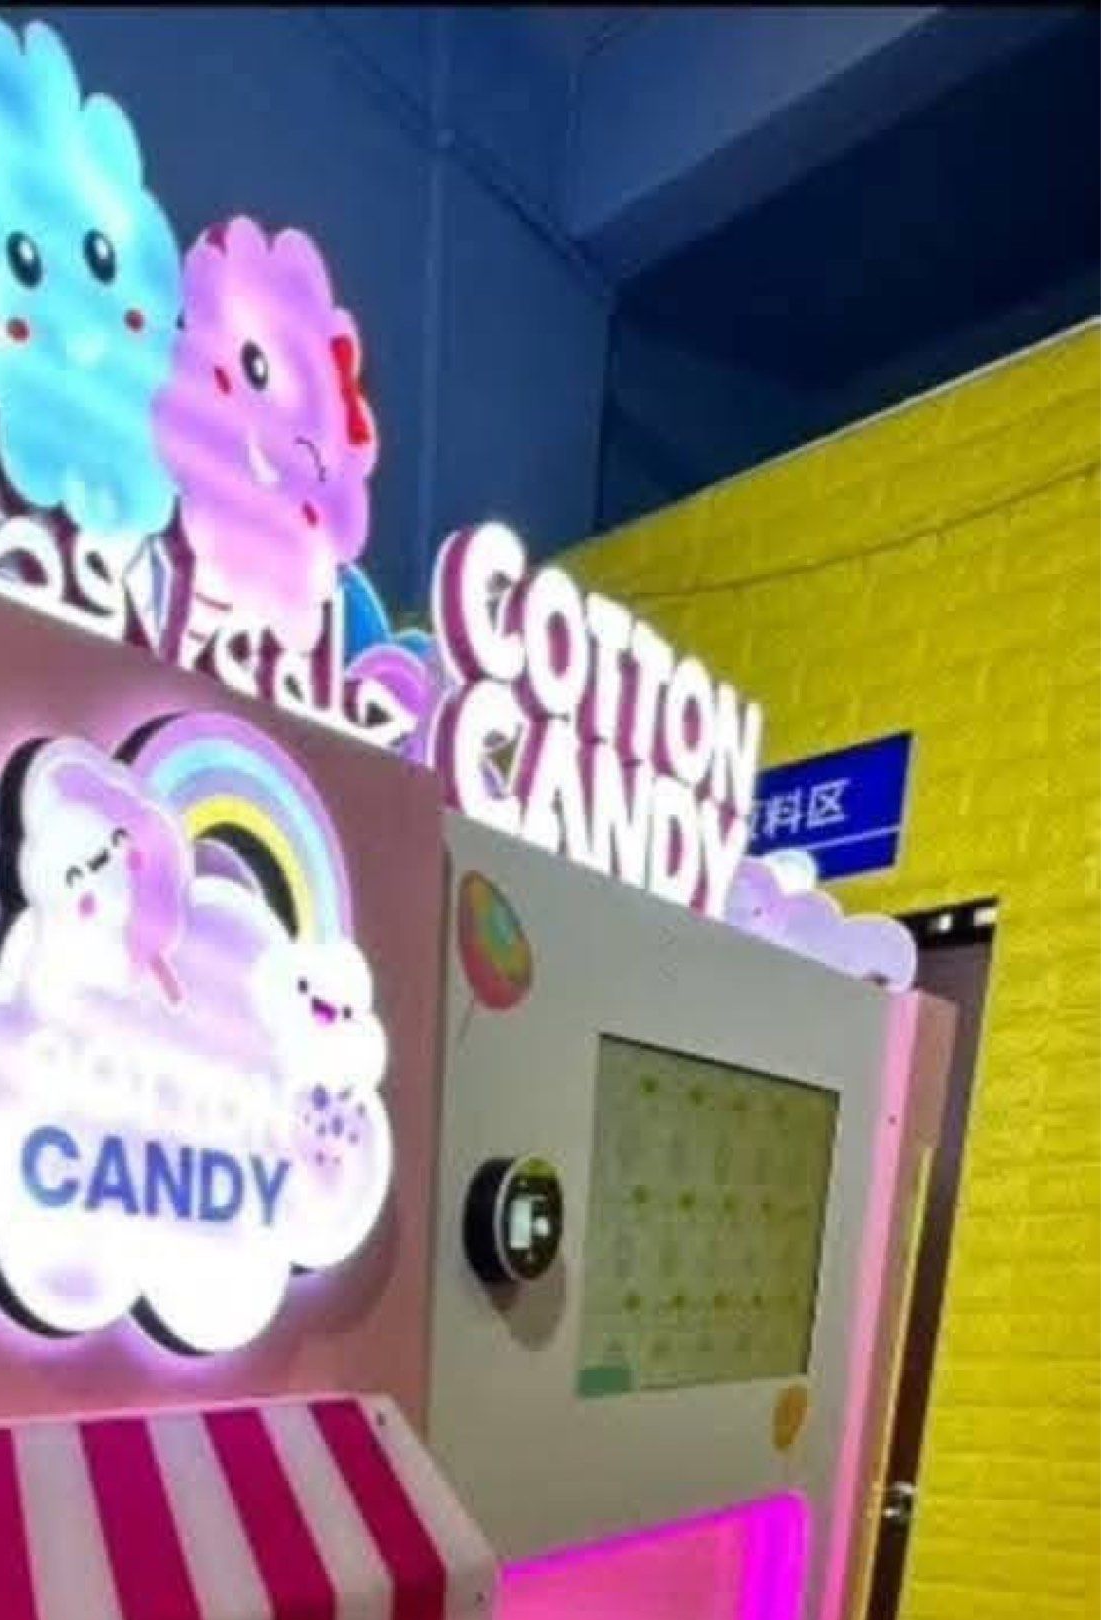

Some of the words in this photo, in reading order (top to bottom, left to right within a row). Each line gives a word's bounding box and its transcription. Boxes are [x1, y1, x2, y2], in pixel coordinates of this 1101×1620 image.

[434, 521, 763, 804] COTTON
[429, 680, 755, 919] CANDY
[747, 776, 851, 841] 料区
[20, 1124, 291, 1227] CANDY
